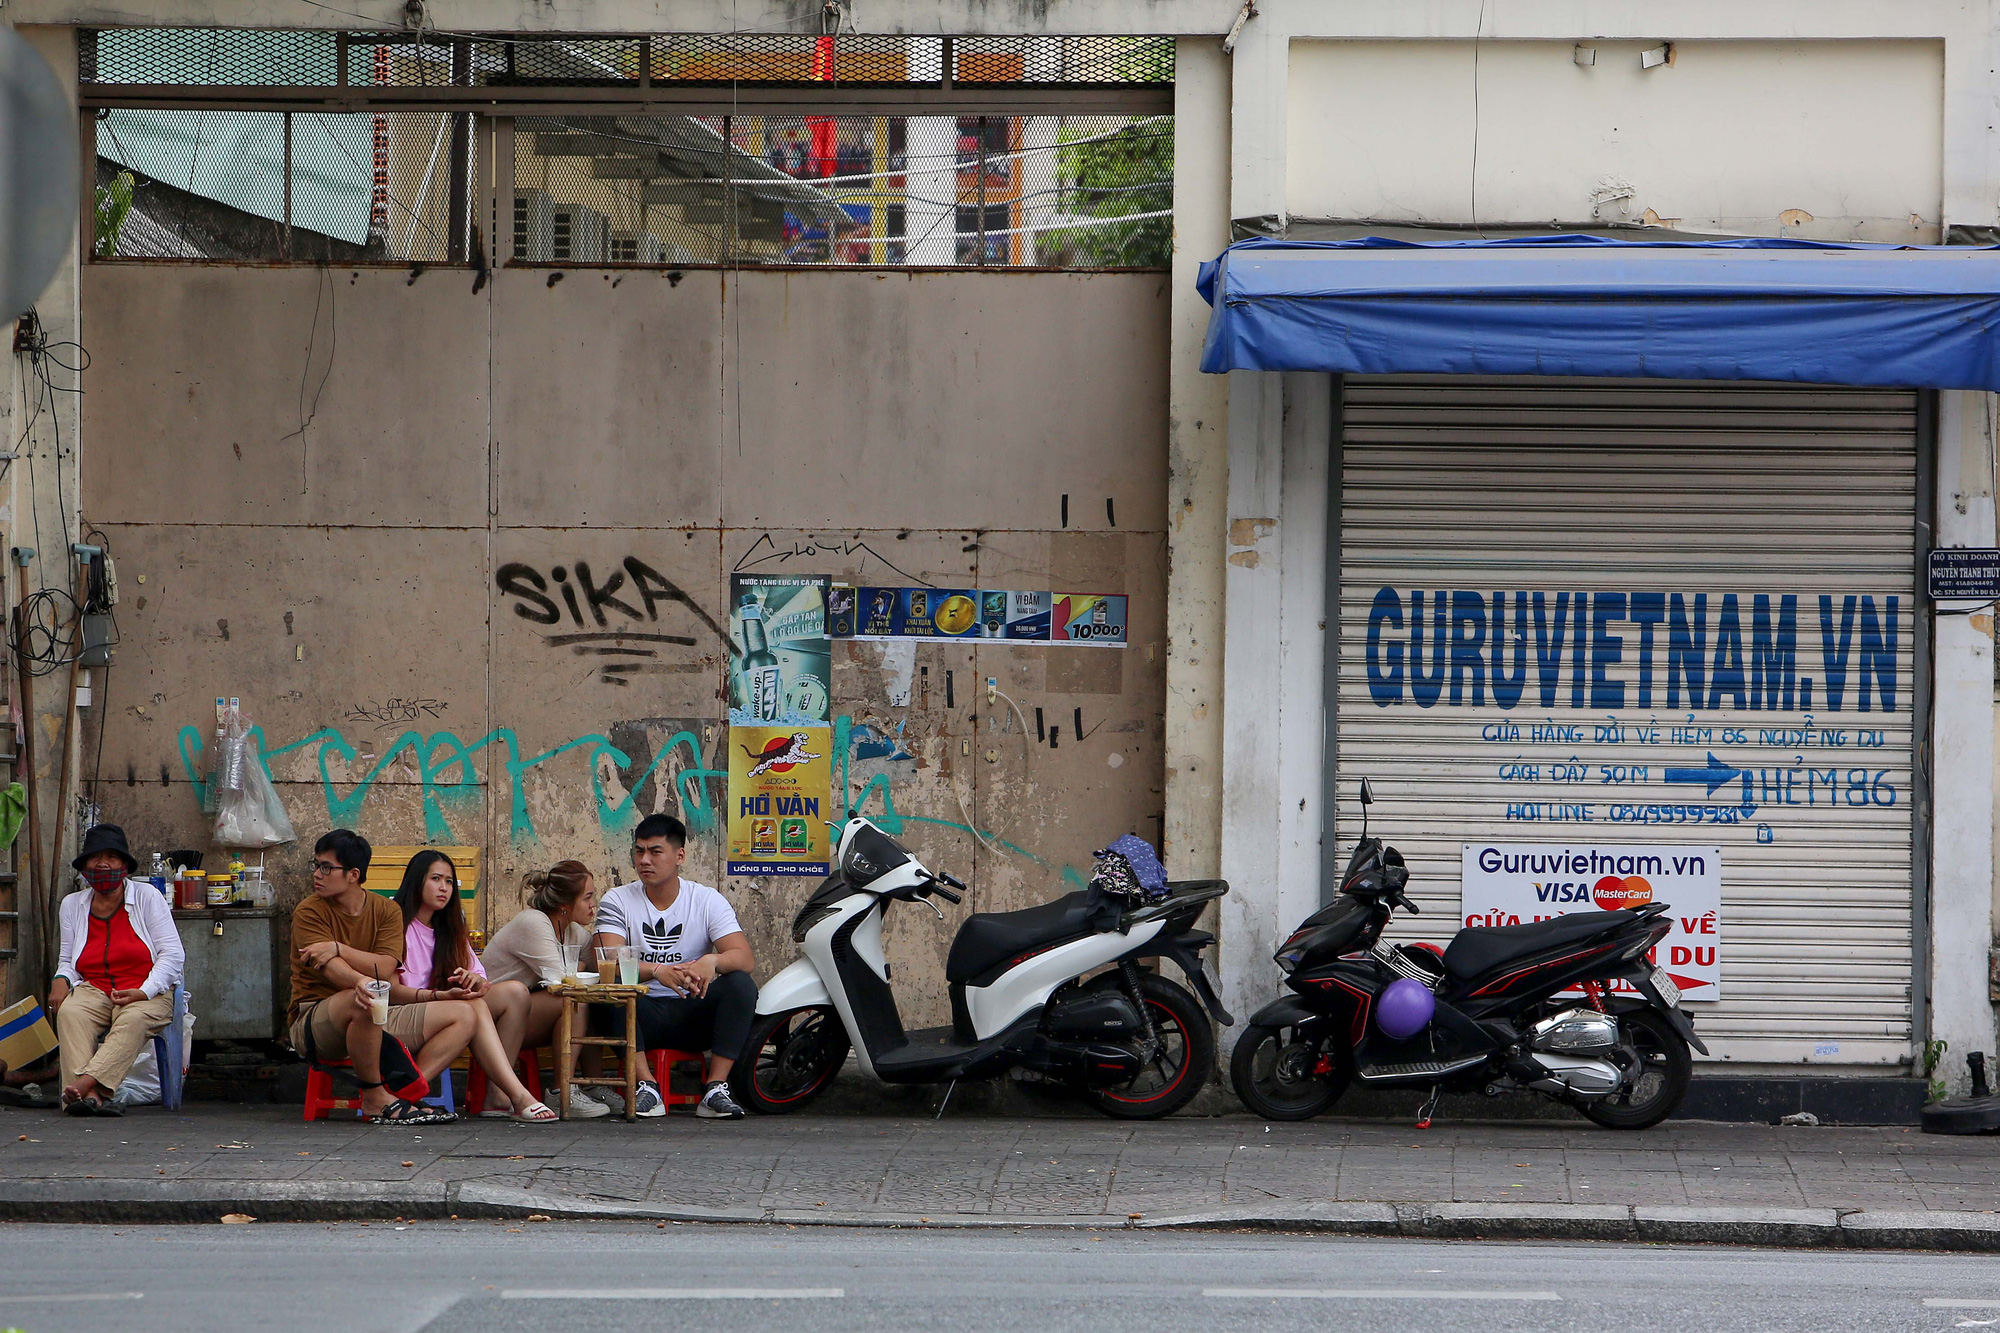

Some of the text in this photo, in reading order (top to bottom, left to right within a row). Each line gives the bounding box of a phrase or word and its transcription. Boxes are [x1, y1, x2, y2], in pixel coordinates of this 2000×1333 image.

[1933, 553, 1945, 561] HỘ
[1960, 568, 1981, 578] THANH
[1366, 586, 1899, 712] GURUVIETNAM.VN
[1531, 717, 1584, 743] HÀNG
[1636, 714, 1660, 744] VỀ
[1671, 714, 1712, 745] HẺM
[1721, 728, 1747, 744] 86
[1857, 730, 1884, 747] DU
[1499, 755, 1540, 782] CÁCH
[1548, 755, 1589, 784] ĐÂY
[1762, 755, 1897, 806] HẺM 86
[741, 792, 770, 819] HỔ
[1506, 803, 1596, 821] HOTLINE
[733, 864, 759, 872] UỐNG
[799, 865, 824, 873] KHỎE
[1479, 848, 1705, 875] Guruvietnam.vn
[1532, 883, 1651, 902] VISA MasterCard
[1681, 911, 1717, 934] VỀ
[639, 951, 682, 963] adidas
[1670, 946, 1715, 966] DU
